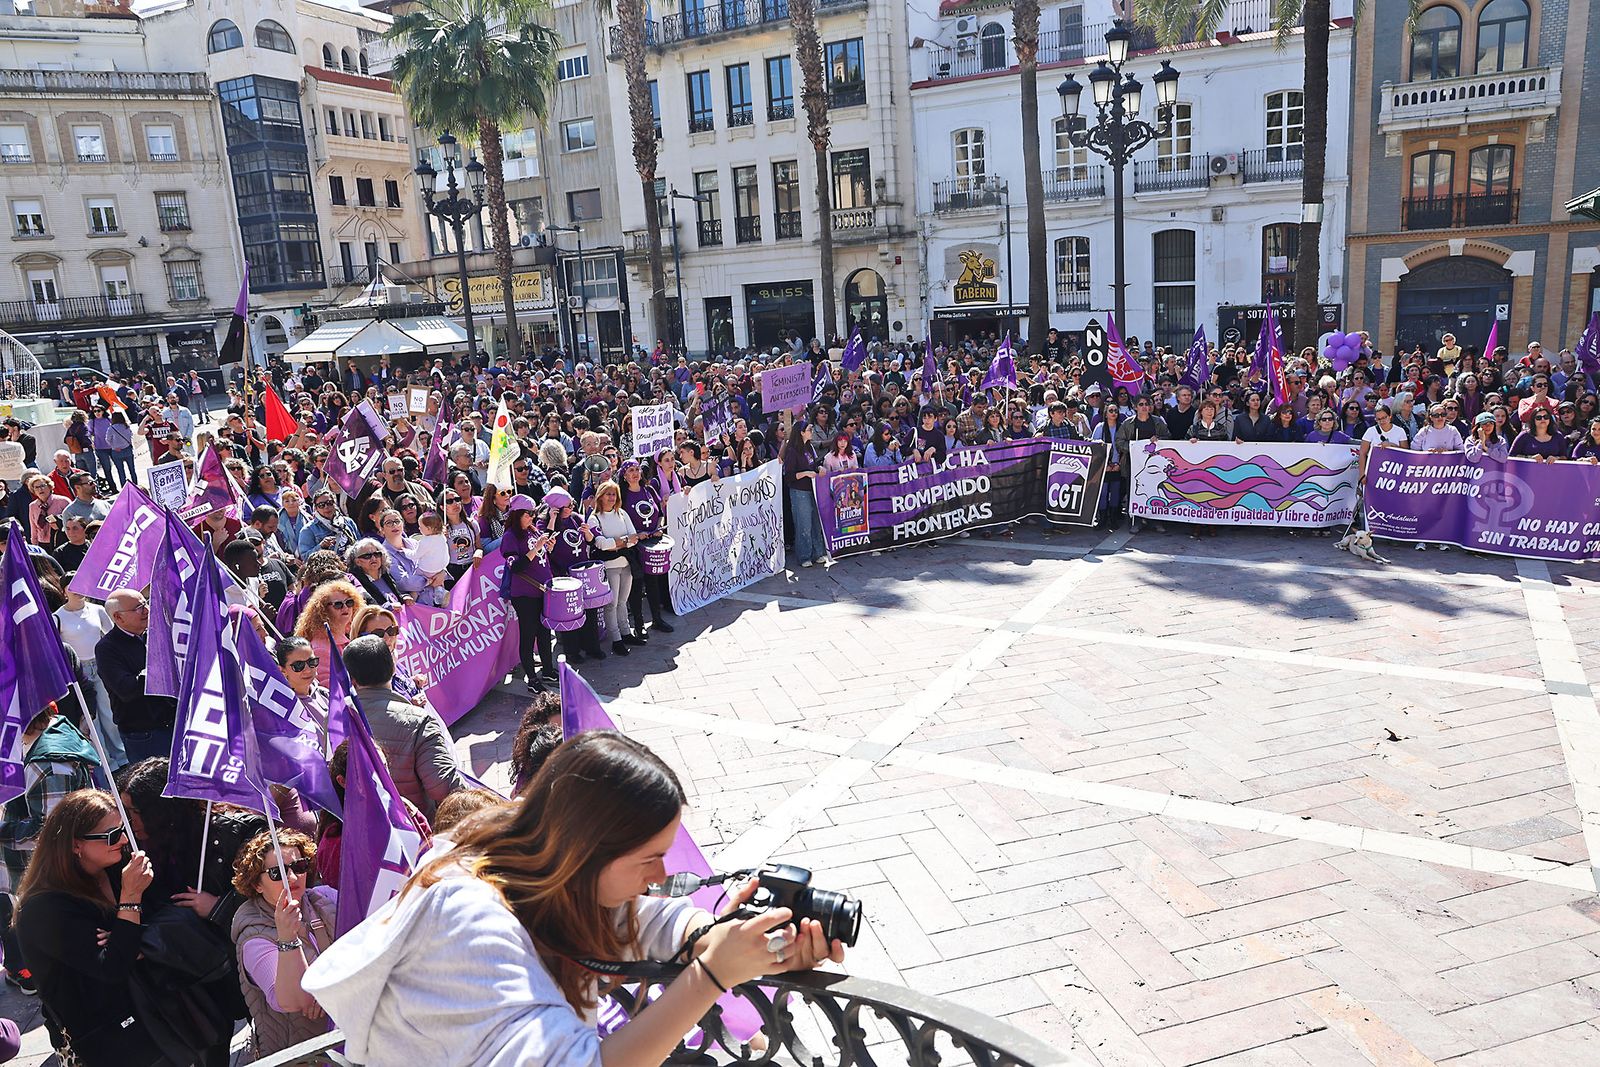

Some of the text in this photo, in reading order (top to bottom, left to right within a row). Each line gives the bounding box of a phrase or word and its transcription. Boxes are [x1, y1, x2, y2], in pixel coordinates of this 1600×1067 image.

[759, 287, 803, 299] BLISS
[956, 287, 995, 300] TABERNI
[1051, 441, 1092, 455] HUELVA
[898, 463, 919, 484] EN
[1378, 460, 1484, 480] SIN FEMINISMO
[159, 474, 176, 487] 8M
[1375, 476, 1482, 499] NO HAY CAMBIO.
[891, 475, 991, 513] ROMPIENDO
[1048, 483, 1083, 510] CGT
[840, 510, 846, 521] EN
[846, 507, 862, 519] LUCHA
[893, 502, 993, 541] FRONTERAS
[1132, 502, 1353, 523] Por una sociedad en igualdad y libre de machis
[1517, 517, 1541, 531] NO
[1545, 520, 1579, 535] HAY
[832, 535, 871, 550] HUELVA
[1478, 530, 1505, 546] SIN
[1508, 534, 1581, 553] TRABAJO
[652, 566, 663, 574] 8M
[447, 652, 462, 673] AL
[458, 622, 507, 662] MUND
